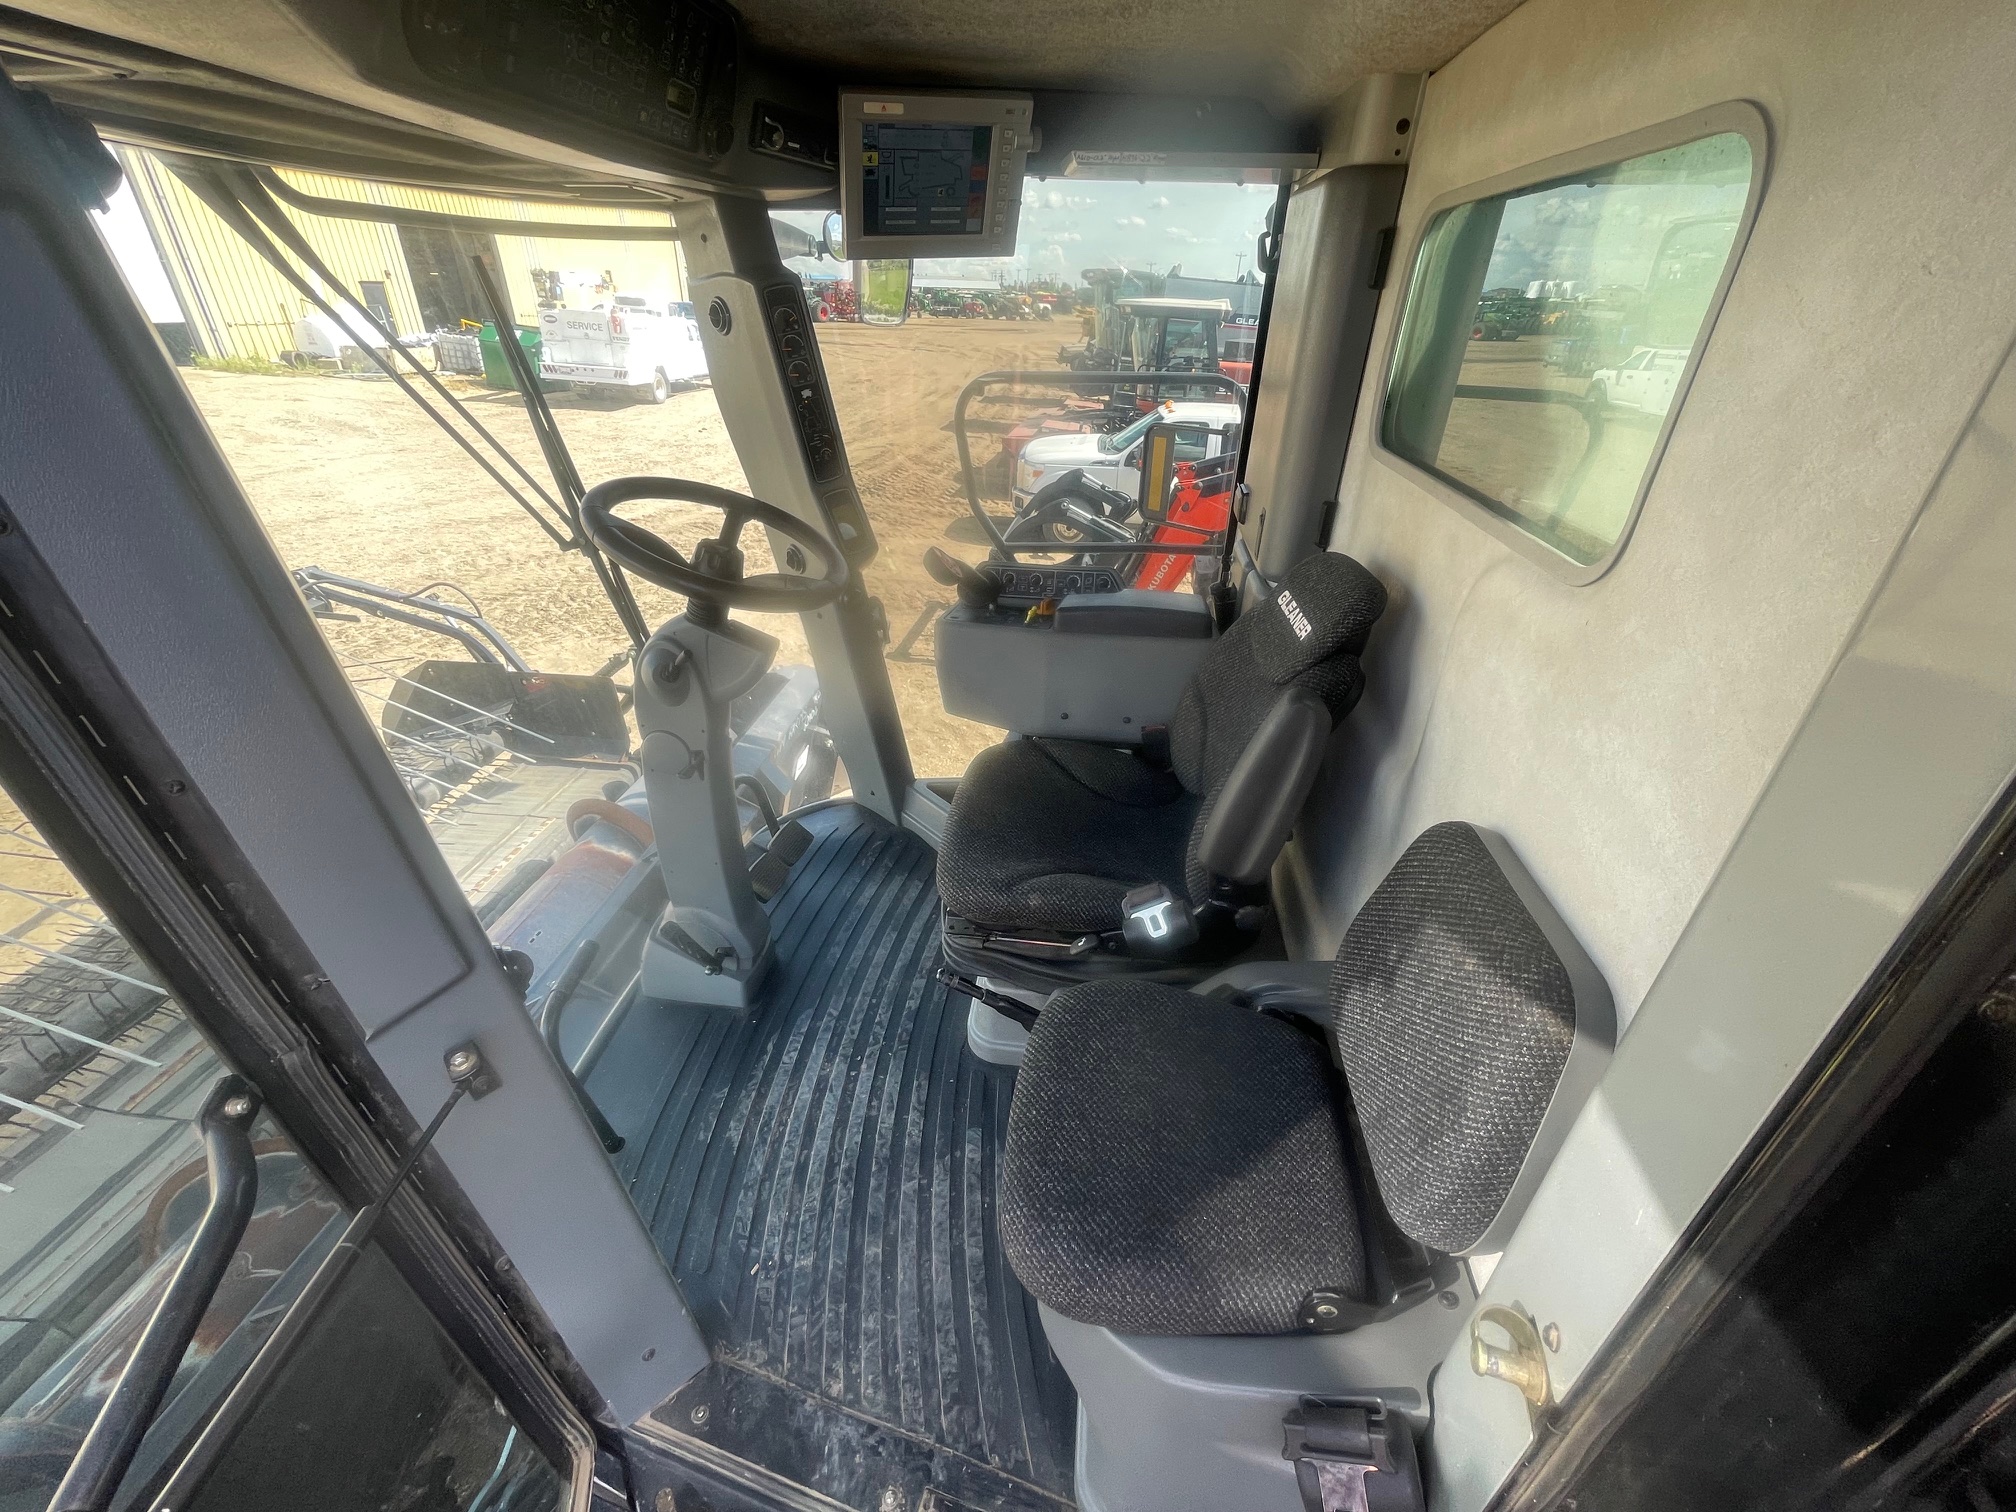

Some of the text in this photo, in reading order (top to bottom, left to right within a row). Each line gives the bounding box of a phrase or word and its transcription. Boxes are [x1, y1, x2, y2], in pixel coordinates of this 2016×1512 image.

[566, 320, 604, 332] SERVICE
[1147, 554, 1177, 591] KUBOTA
[1277, 590, 1312, 641] GLEANER
